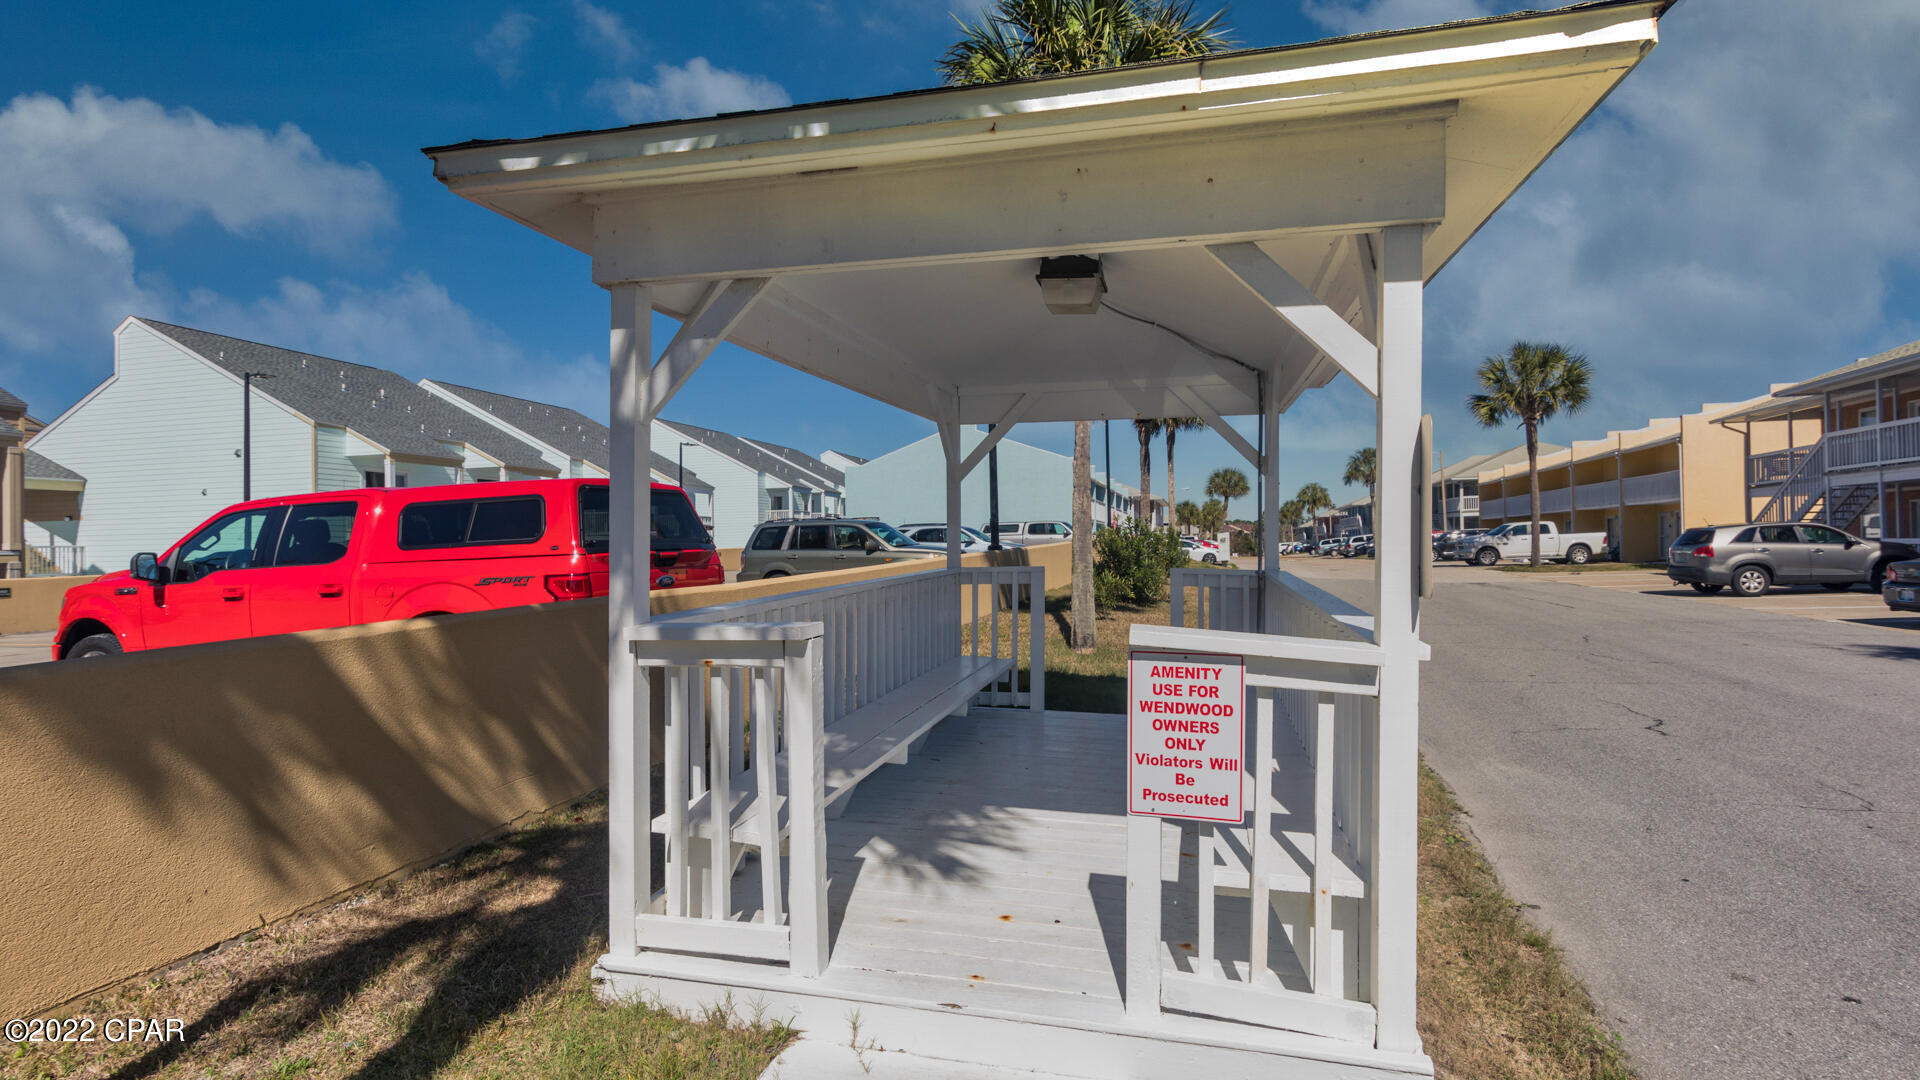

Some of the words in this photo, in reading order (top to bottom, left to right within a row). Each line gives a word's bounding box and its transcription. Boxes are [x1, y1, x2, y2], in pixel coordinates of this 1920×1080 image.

[475, 575, 536, 587] SPORT
[1150, 665, 1222, 680] AMENITY
[1152, 683, 1182, 696] USE
[1189, 685, 1219, 698] FOR
[1139, 700, 1234, 717] WENDWOOD
[1152, 719, 1220, 734] OWNERS
[1164, 737, 1206, 751] ONLY
[1135, 752, 1203, 769] Violators
[1209, 757, 1238, 771] Will
[1175, 773, 1195, 786] Be
[1142, 788, 1229, 807] Prosecuted
